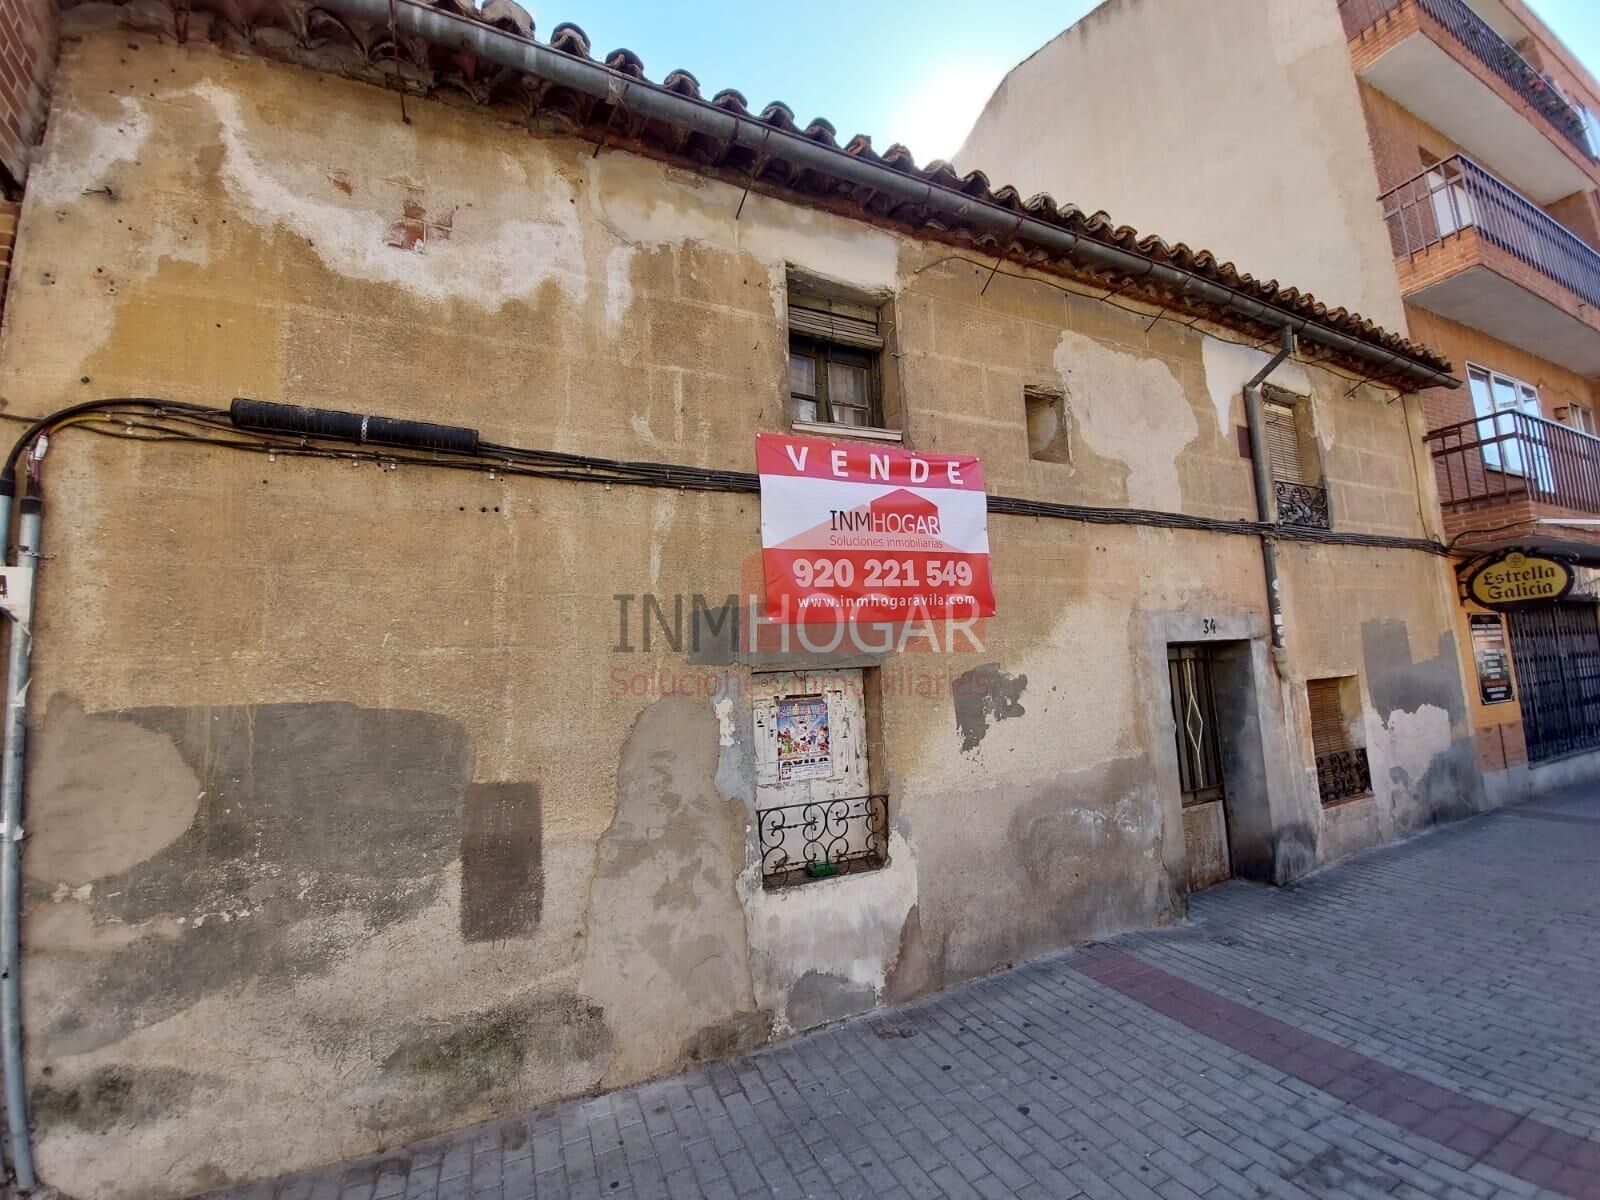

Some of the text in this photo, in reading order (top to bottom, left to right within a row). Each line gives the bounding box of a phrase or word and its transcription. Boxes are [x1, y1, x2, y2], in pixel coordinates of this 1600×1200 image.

[785, 445, 964, 485] VENDE
[829, 510, 941, 535] INMHOGAR
[829, 535, 944, 549] Soluciones inmobiliarias
[792, 558, 973, 588] 920 221 549
[1482, 566, 1556, 586] Estrella
[1487, 581, 1553, 600] Galicia
[798, 594, 975, 609] www.inmhogaravila.com
[1203, 618, 1216, 634] 34
